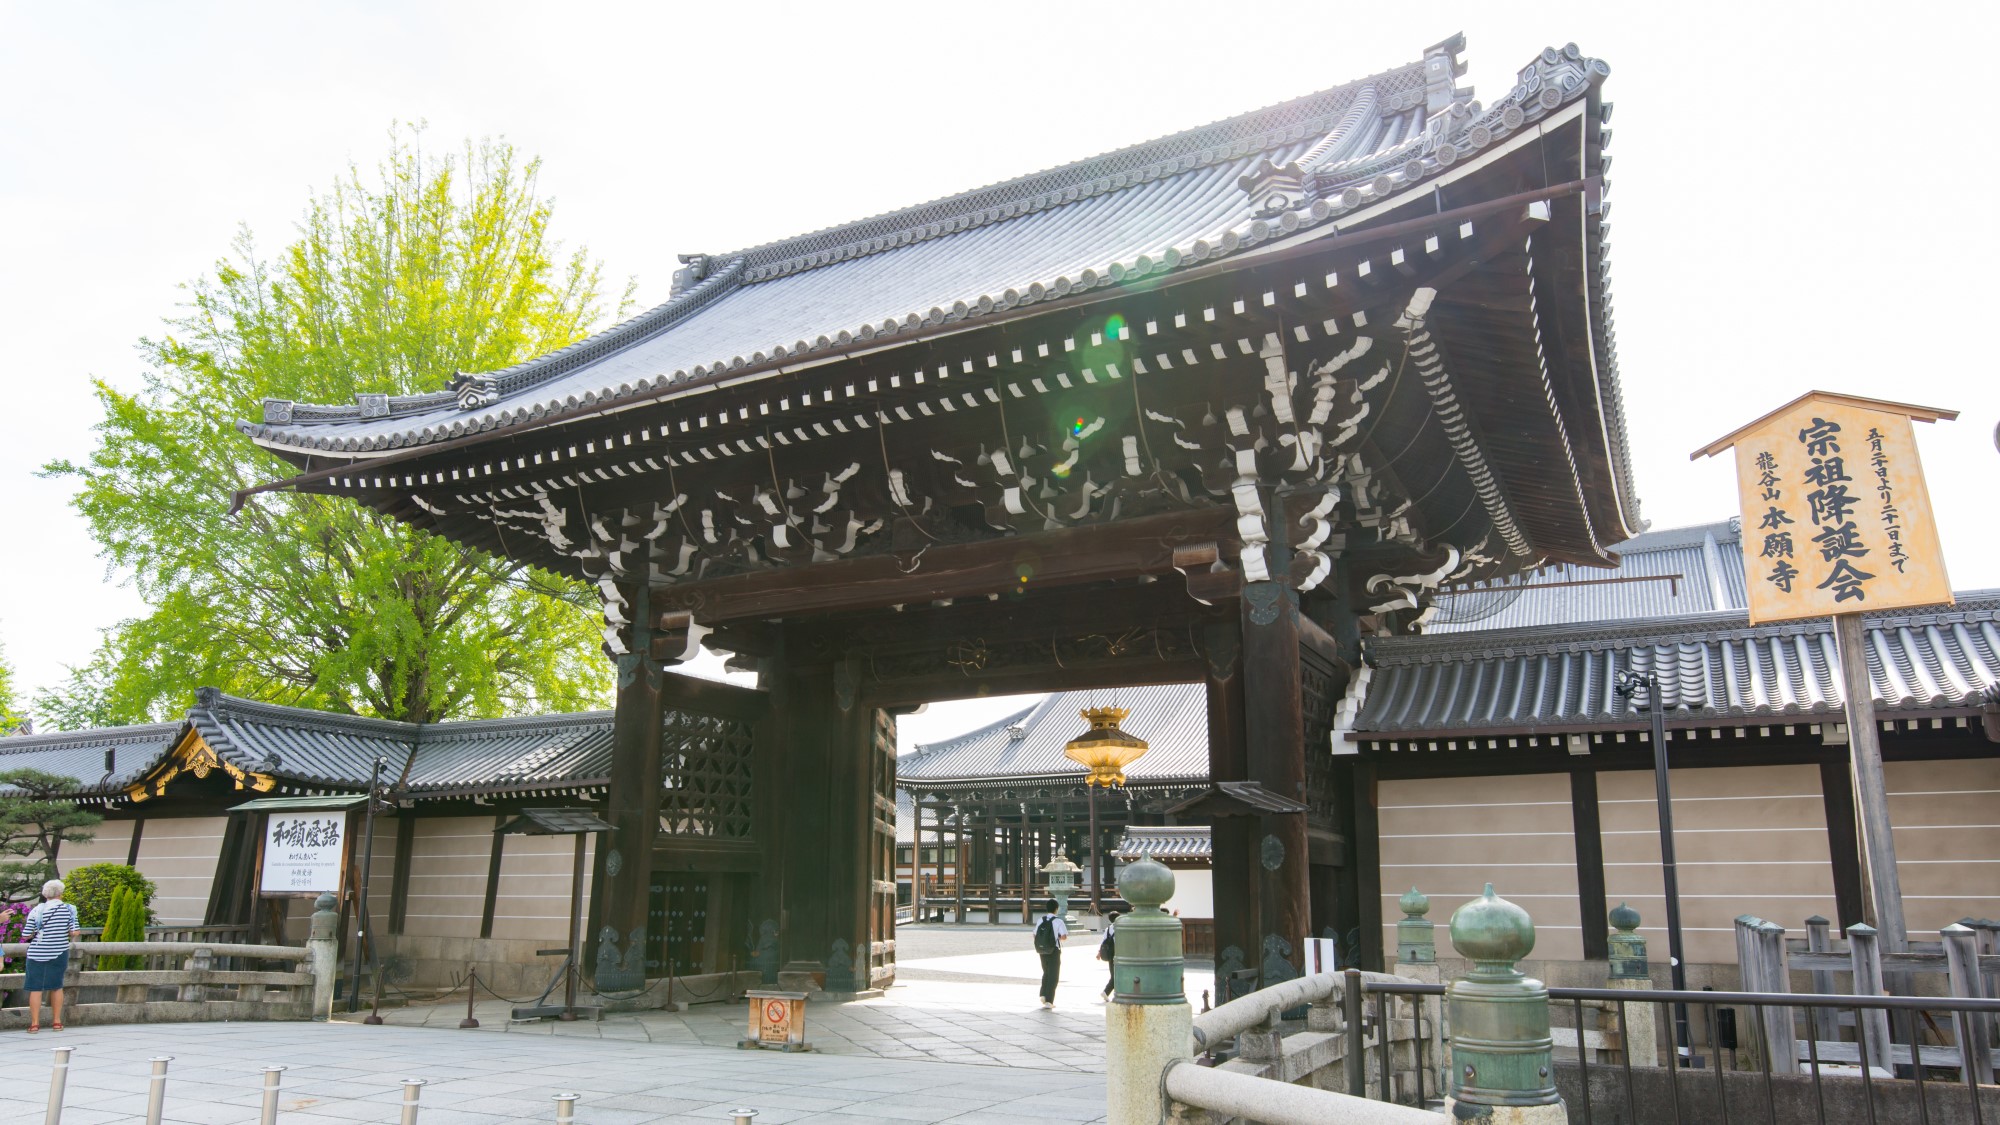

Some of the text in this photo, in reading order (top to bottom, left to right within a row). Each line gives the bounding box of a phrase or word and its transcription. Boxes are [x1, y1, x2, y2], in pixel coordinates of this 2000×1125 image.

[1799, 417, 1876, 603] 宗祖降誕会
[1865, 427, 1909, 574] 五月二十日より二十一日まで
